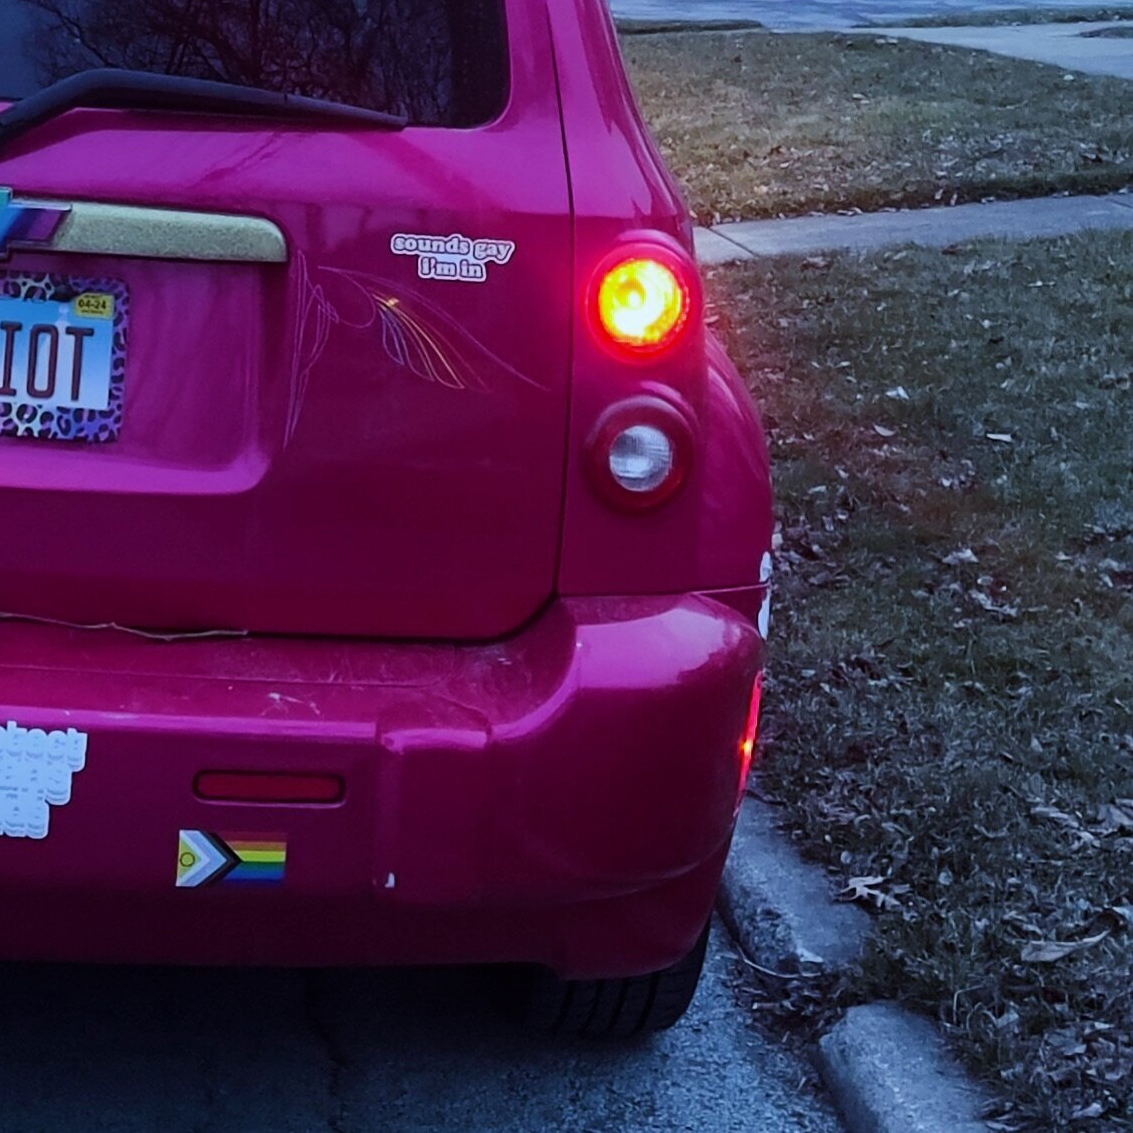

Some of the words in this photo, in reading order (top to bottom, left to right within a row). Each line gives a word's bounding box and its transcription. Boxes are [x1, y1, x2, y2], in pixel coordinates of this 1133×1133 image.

[393, 236, 470, 254] sounds
[473, 241, 511, 260] gay
[421, 256, 456, 276] I'm
[460, 259, 482, 278] in
